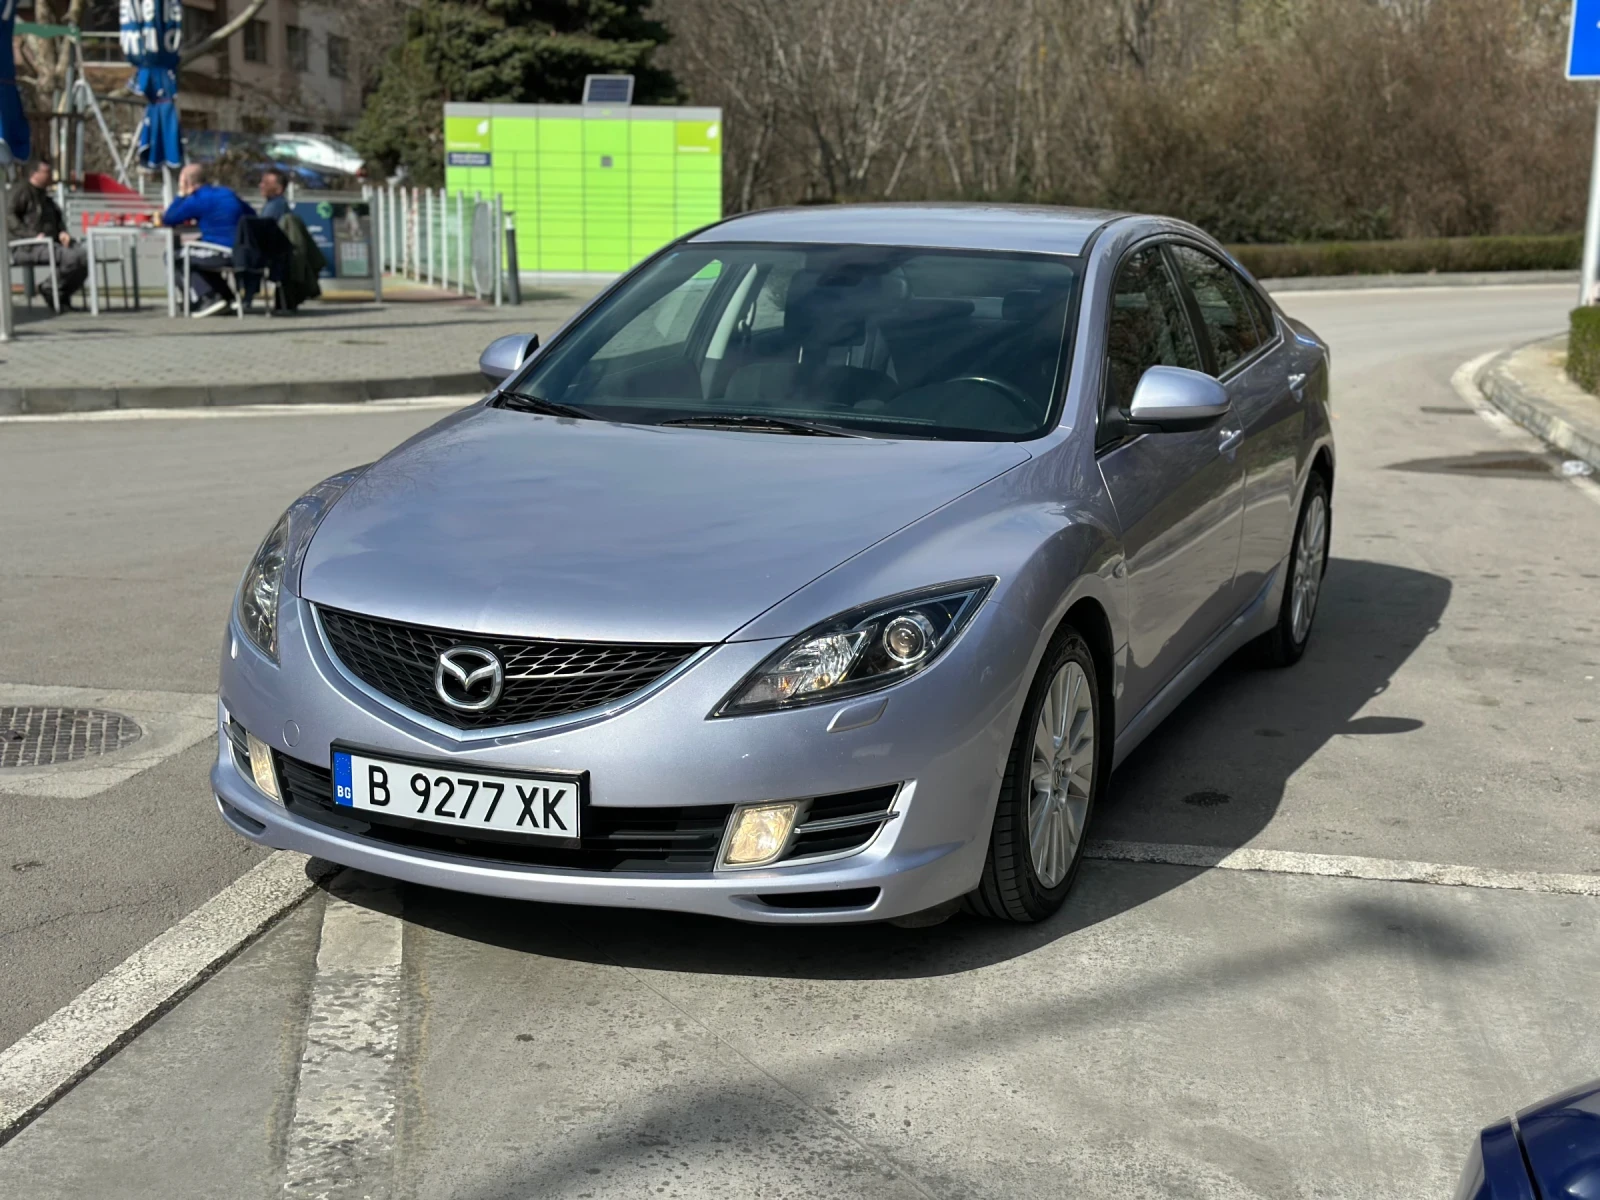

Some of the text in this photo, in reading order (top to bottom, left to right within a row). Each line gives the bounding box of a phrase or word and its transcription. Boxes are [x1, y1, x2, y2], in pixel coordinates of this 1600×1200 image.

[337, 785, 351, 799] BG
[368, 764, 568, 830] B 9277 XK
